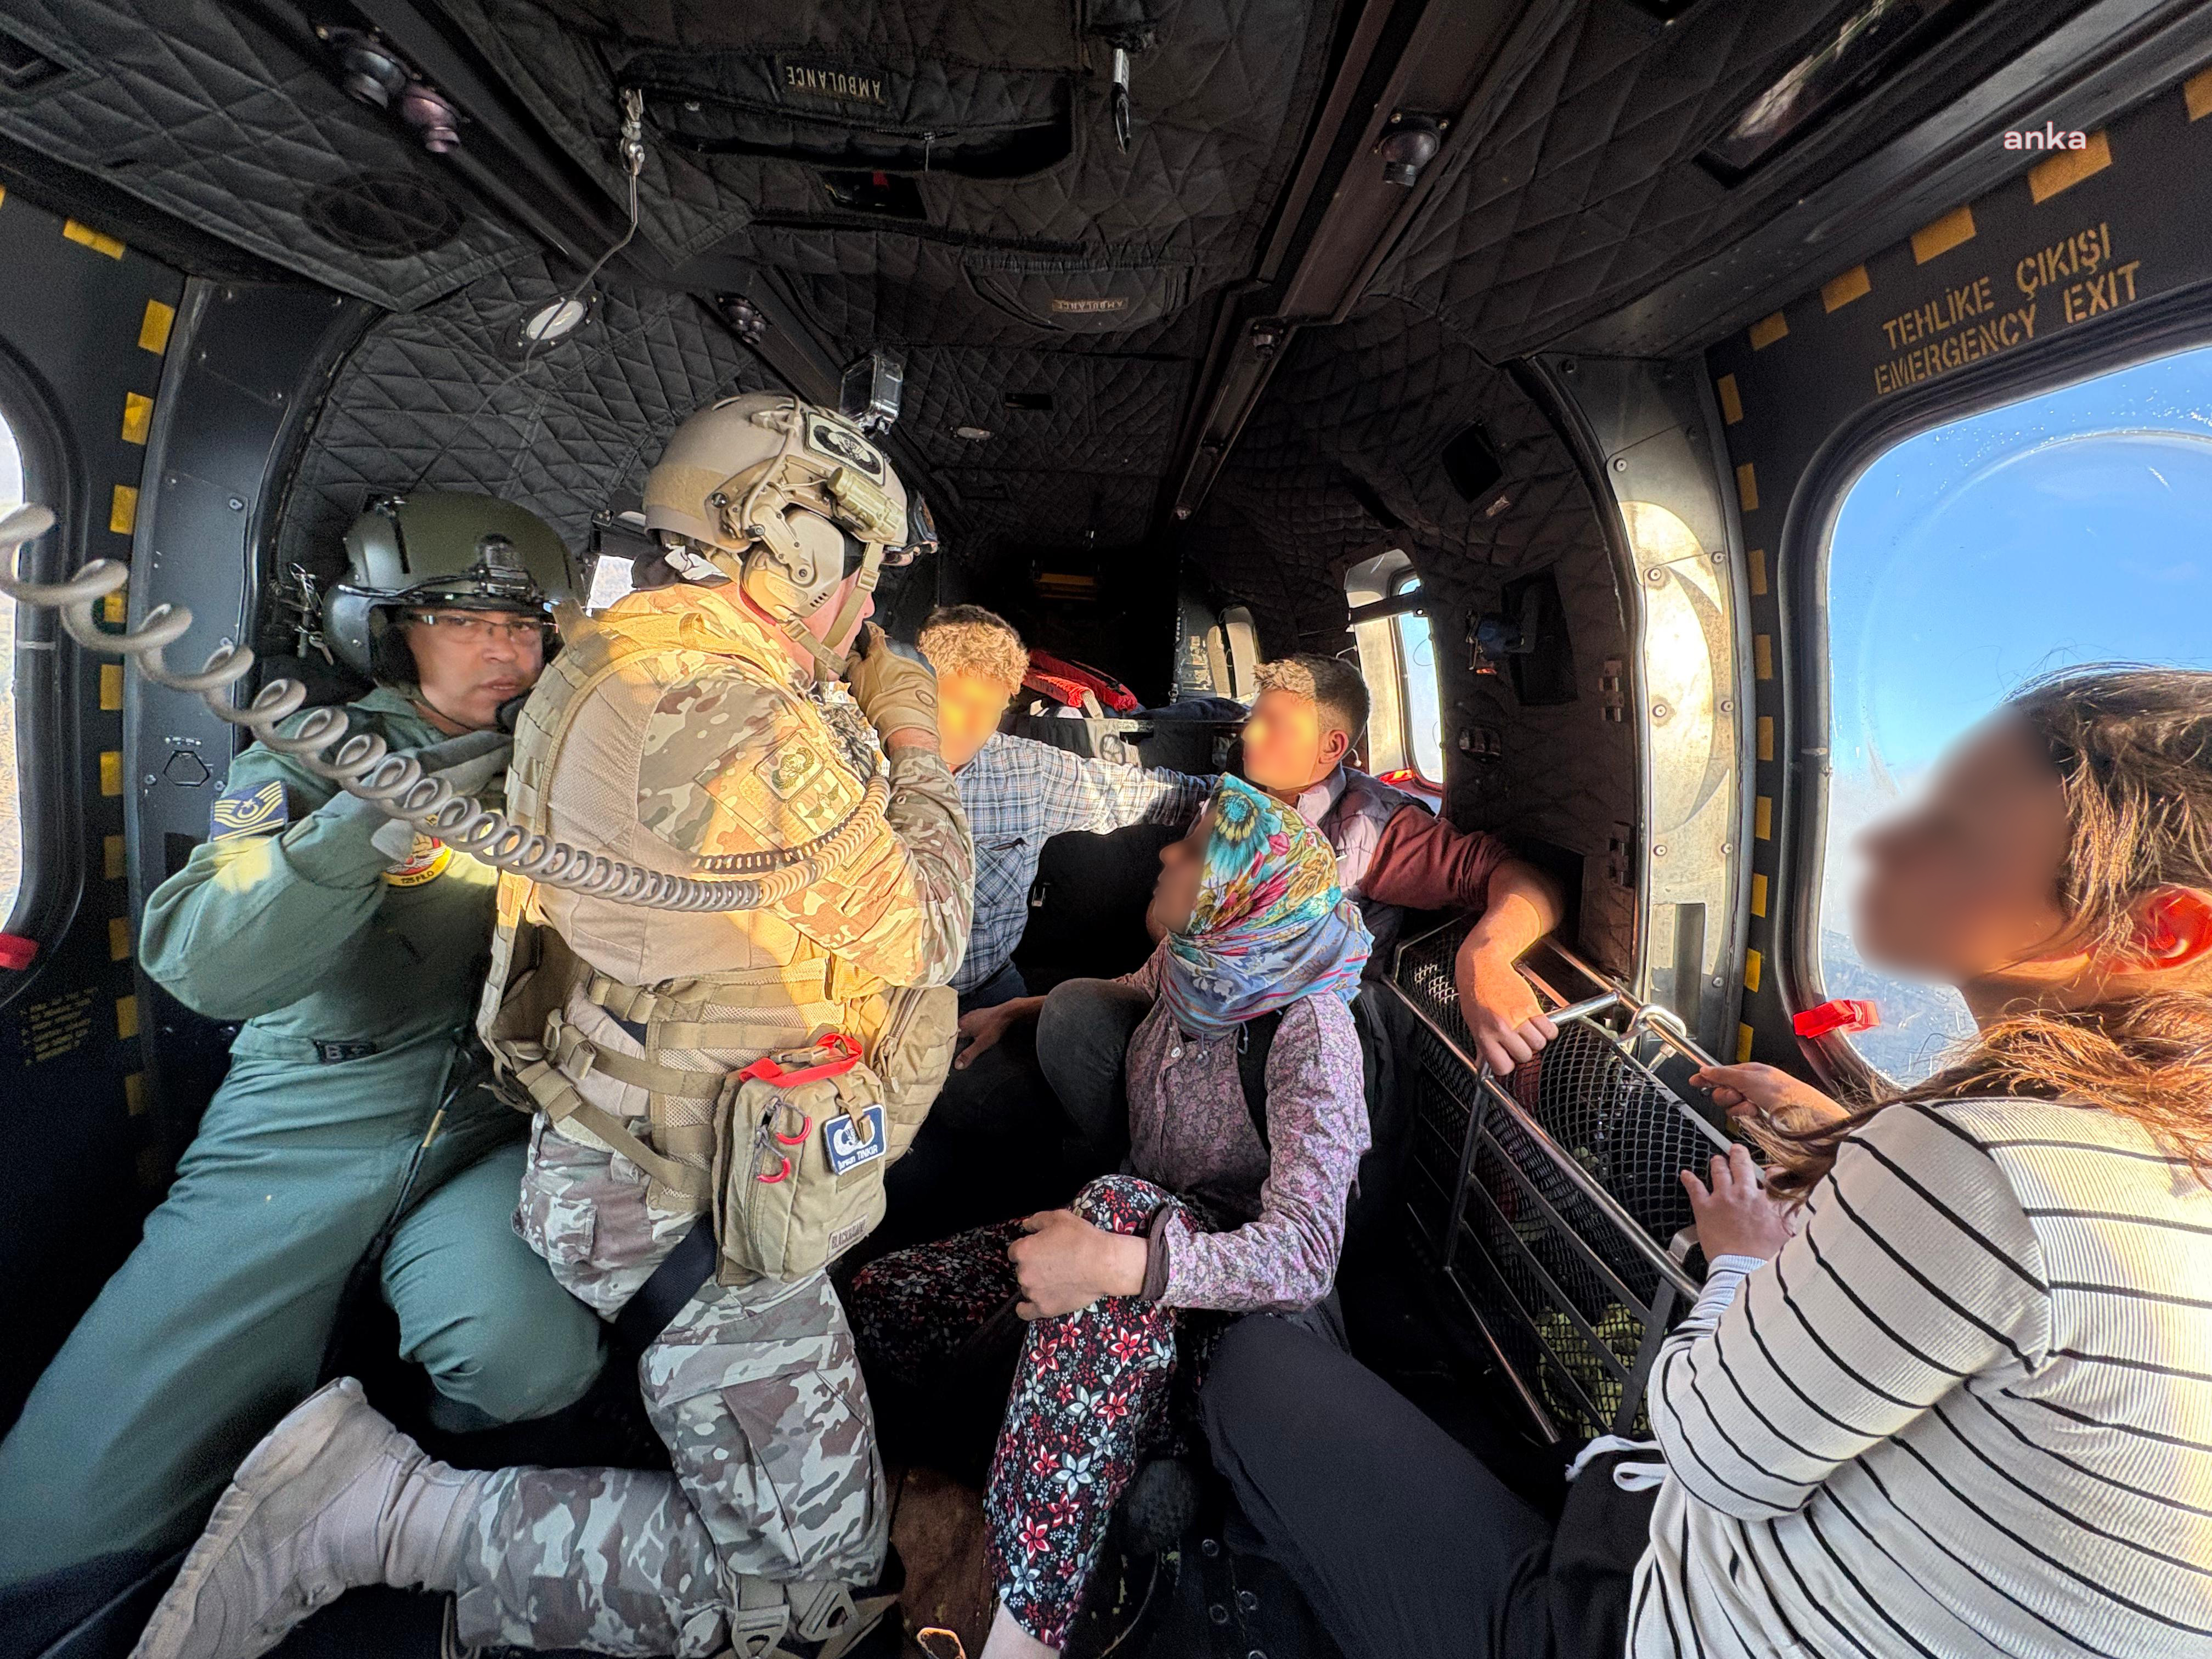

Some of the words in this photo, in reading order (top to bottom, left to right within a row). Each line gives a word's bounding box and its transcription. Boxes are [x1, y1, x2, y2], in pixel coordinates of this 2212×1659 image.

[785, 66, 881, 99] AMBULANCE
[1874, 303, 2036, 394] EMERGENCY
[2063, 260, 2140, 324] EXIT
[1883, 276, 1994, 350] TEHLİKE
[2016, 222, 2111, 301] ÇIKIŞI
